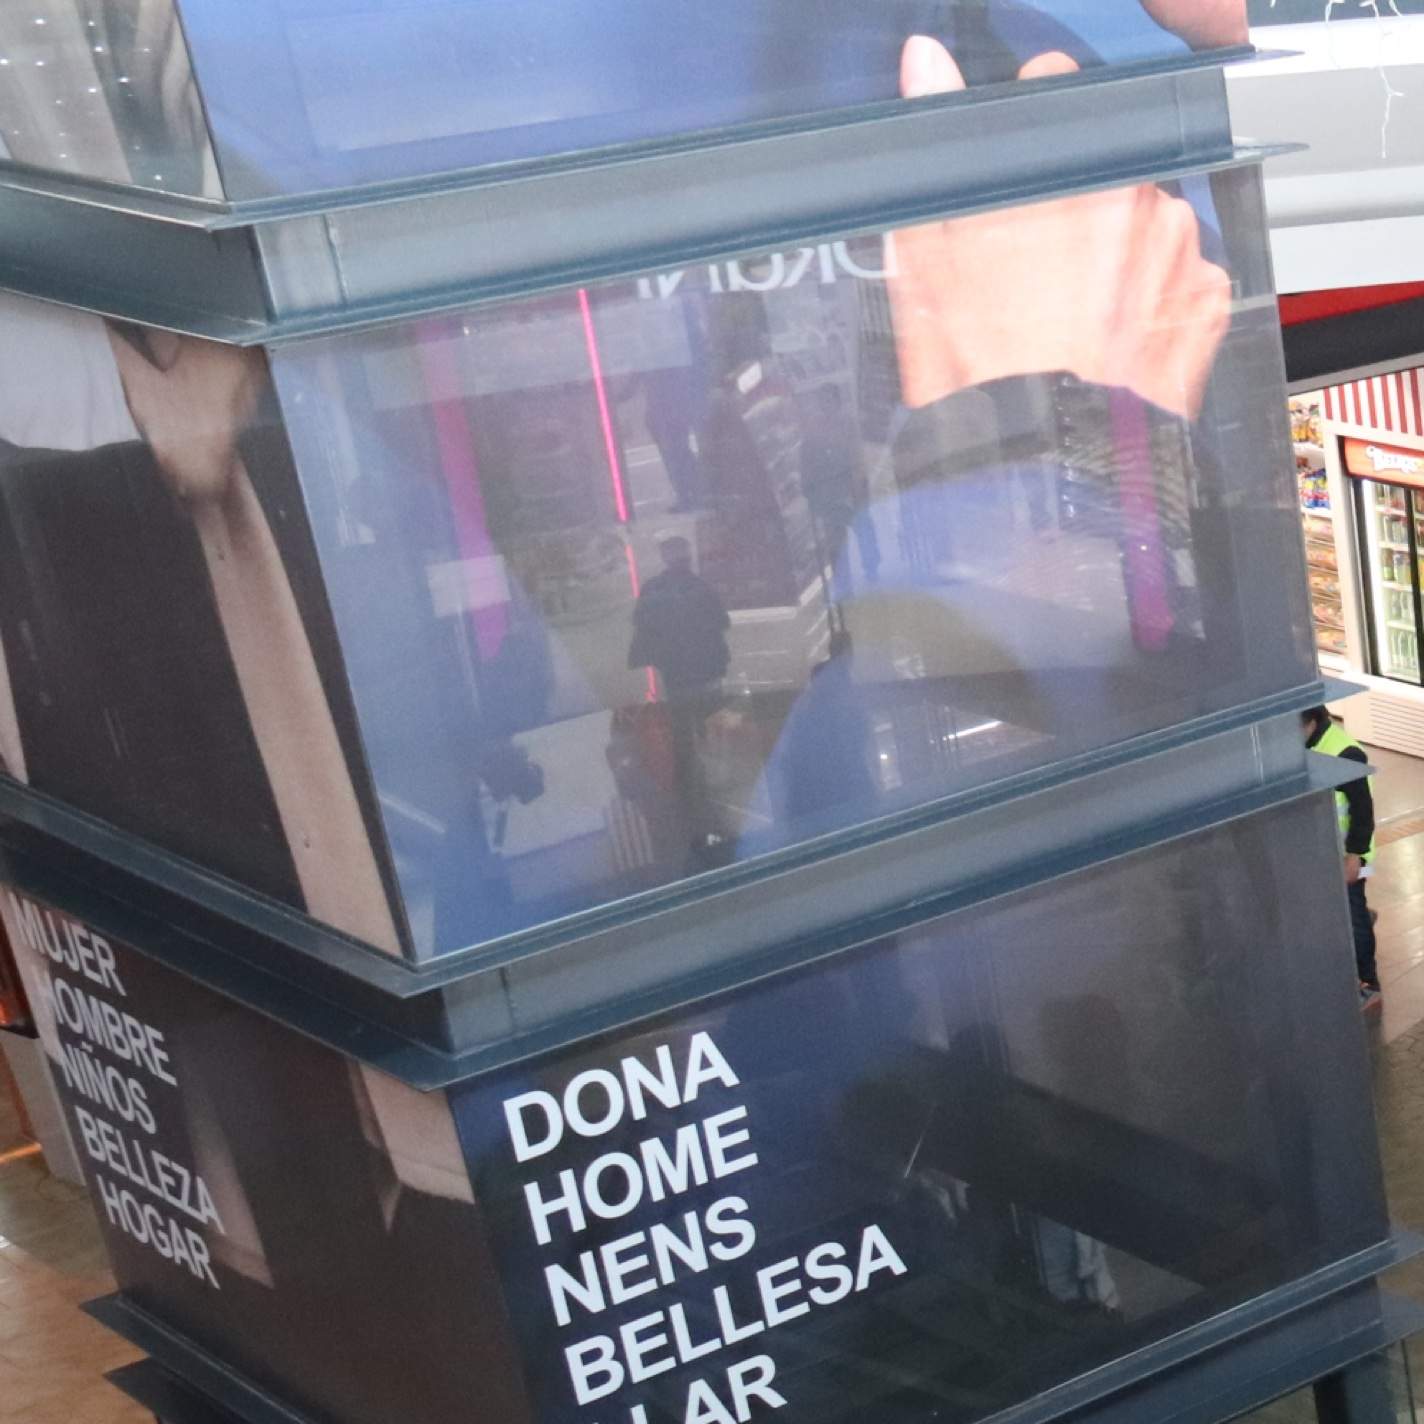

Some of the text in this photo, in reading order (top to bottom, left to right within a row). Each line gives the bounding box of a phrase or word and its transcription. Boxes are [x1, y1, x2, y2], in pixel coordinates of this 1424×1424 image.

[9, 891, 127, 997] MUJER
[58, 1042, 157, 1135] NIÑOS
[502, 1031, 740, 1163] DONA
[74, 1104, 226, 1236] BELLEZA
[97, 1173, 220, 1291] HOGAR
[523, 1104, 759, 1246] HOME
[544, 1196, 756, 1327] NENS
[564, 1224, 908, 1406] BELLESA
